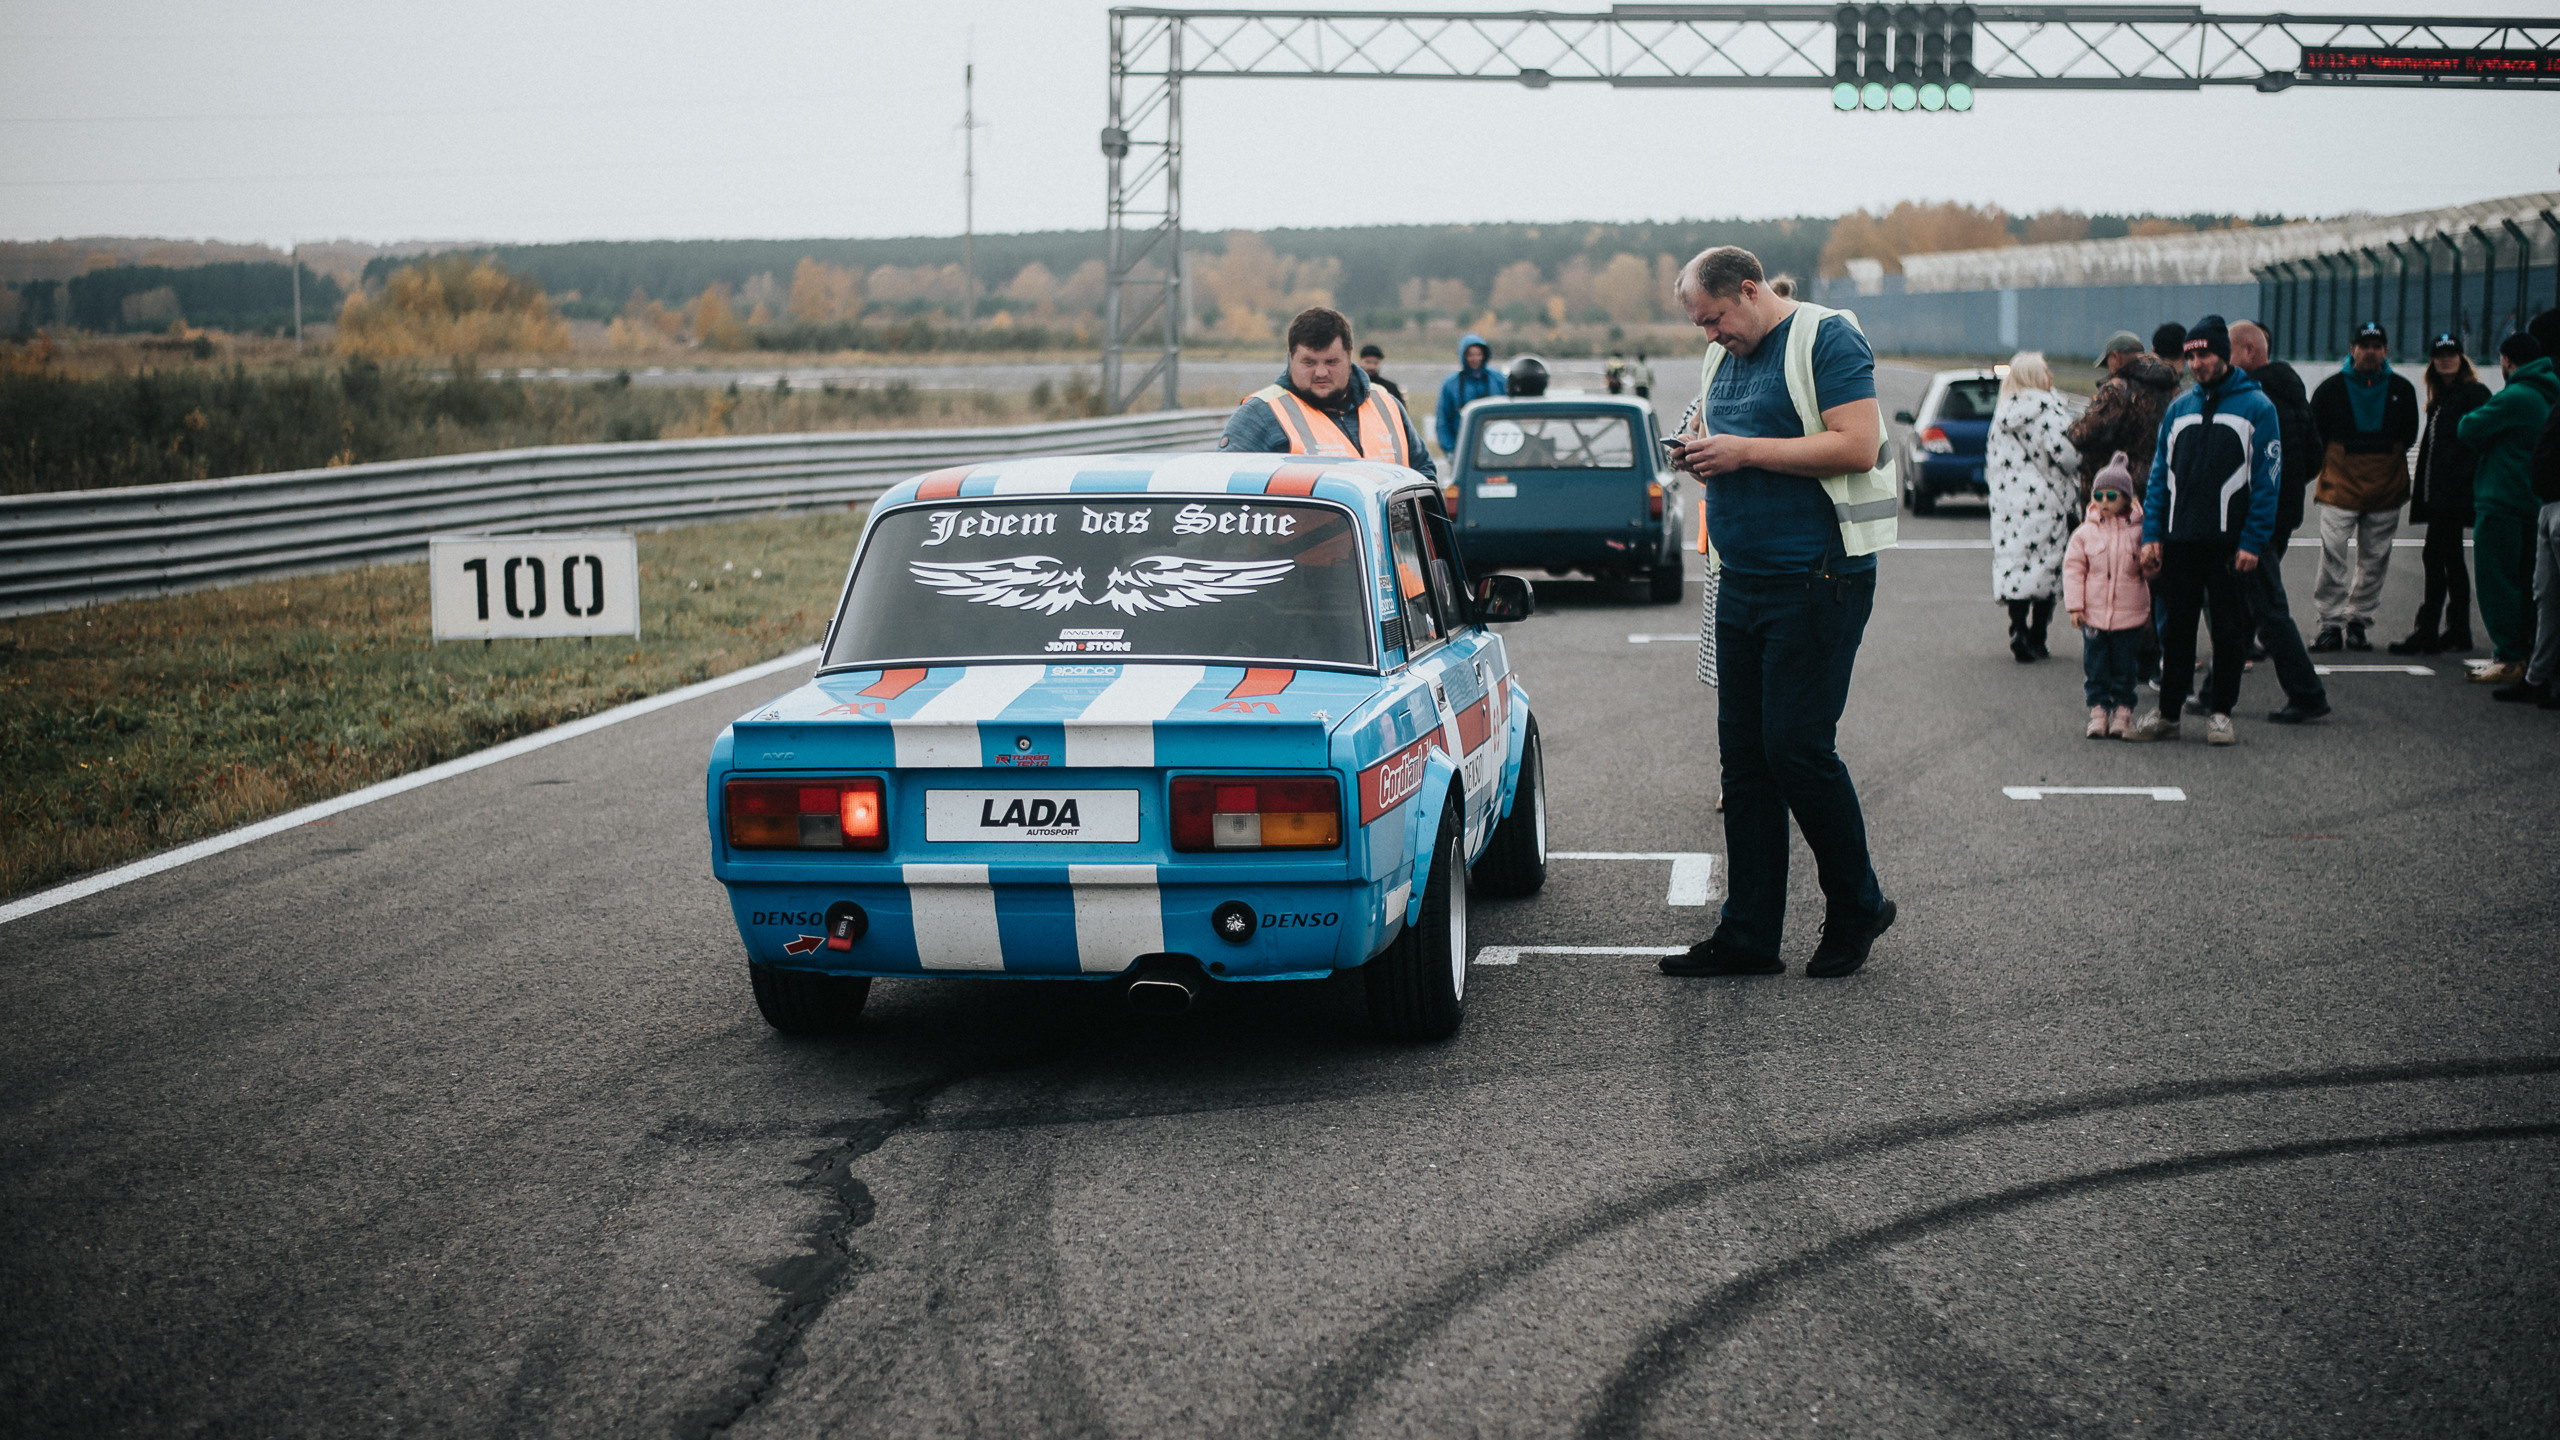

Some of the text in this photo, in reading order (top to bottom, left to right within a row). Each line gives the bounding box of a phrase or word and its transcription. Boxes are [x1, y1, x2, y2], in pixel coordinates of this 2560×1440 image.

[1708, 375, 1781, 402] FABULOUS
[1711, 400, 1762, 417] BROOKLYN
[1489, 432, 1520, 446] 777
[921, 503, 1297, 548] Jedem das Seine
[463, 554, 604, 621] 100
[1051, 666, 1117, 677] sparco
[1464, 753, 1482, 795] DENSO
[980, 798, 1081, 828] LADA
[1026, 828, 1080, 836] AUTOSPORT
[752, 911, 823, 926] DENSO
[1261, 912, 1339, 928] DENSO
